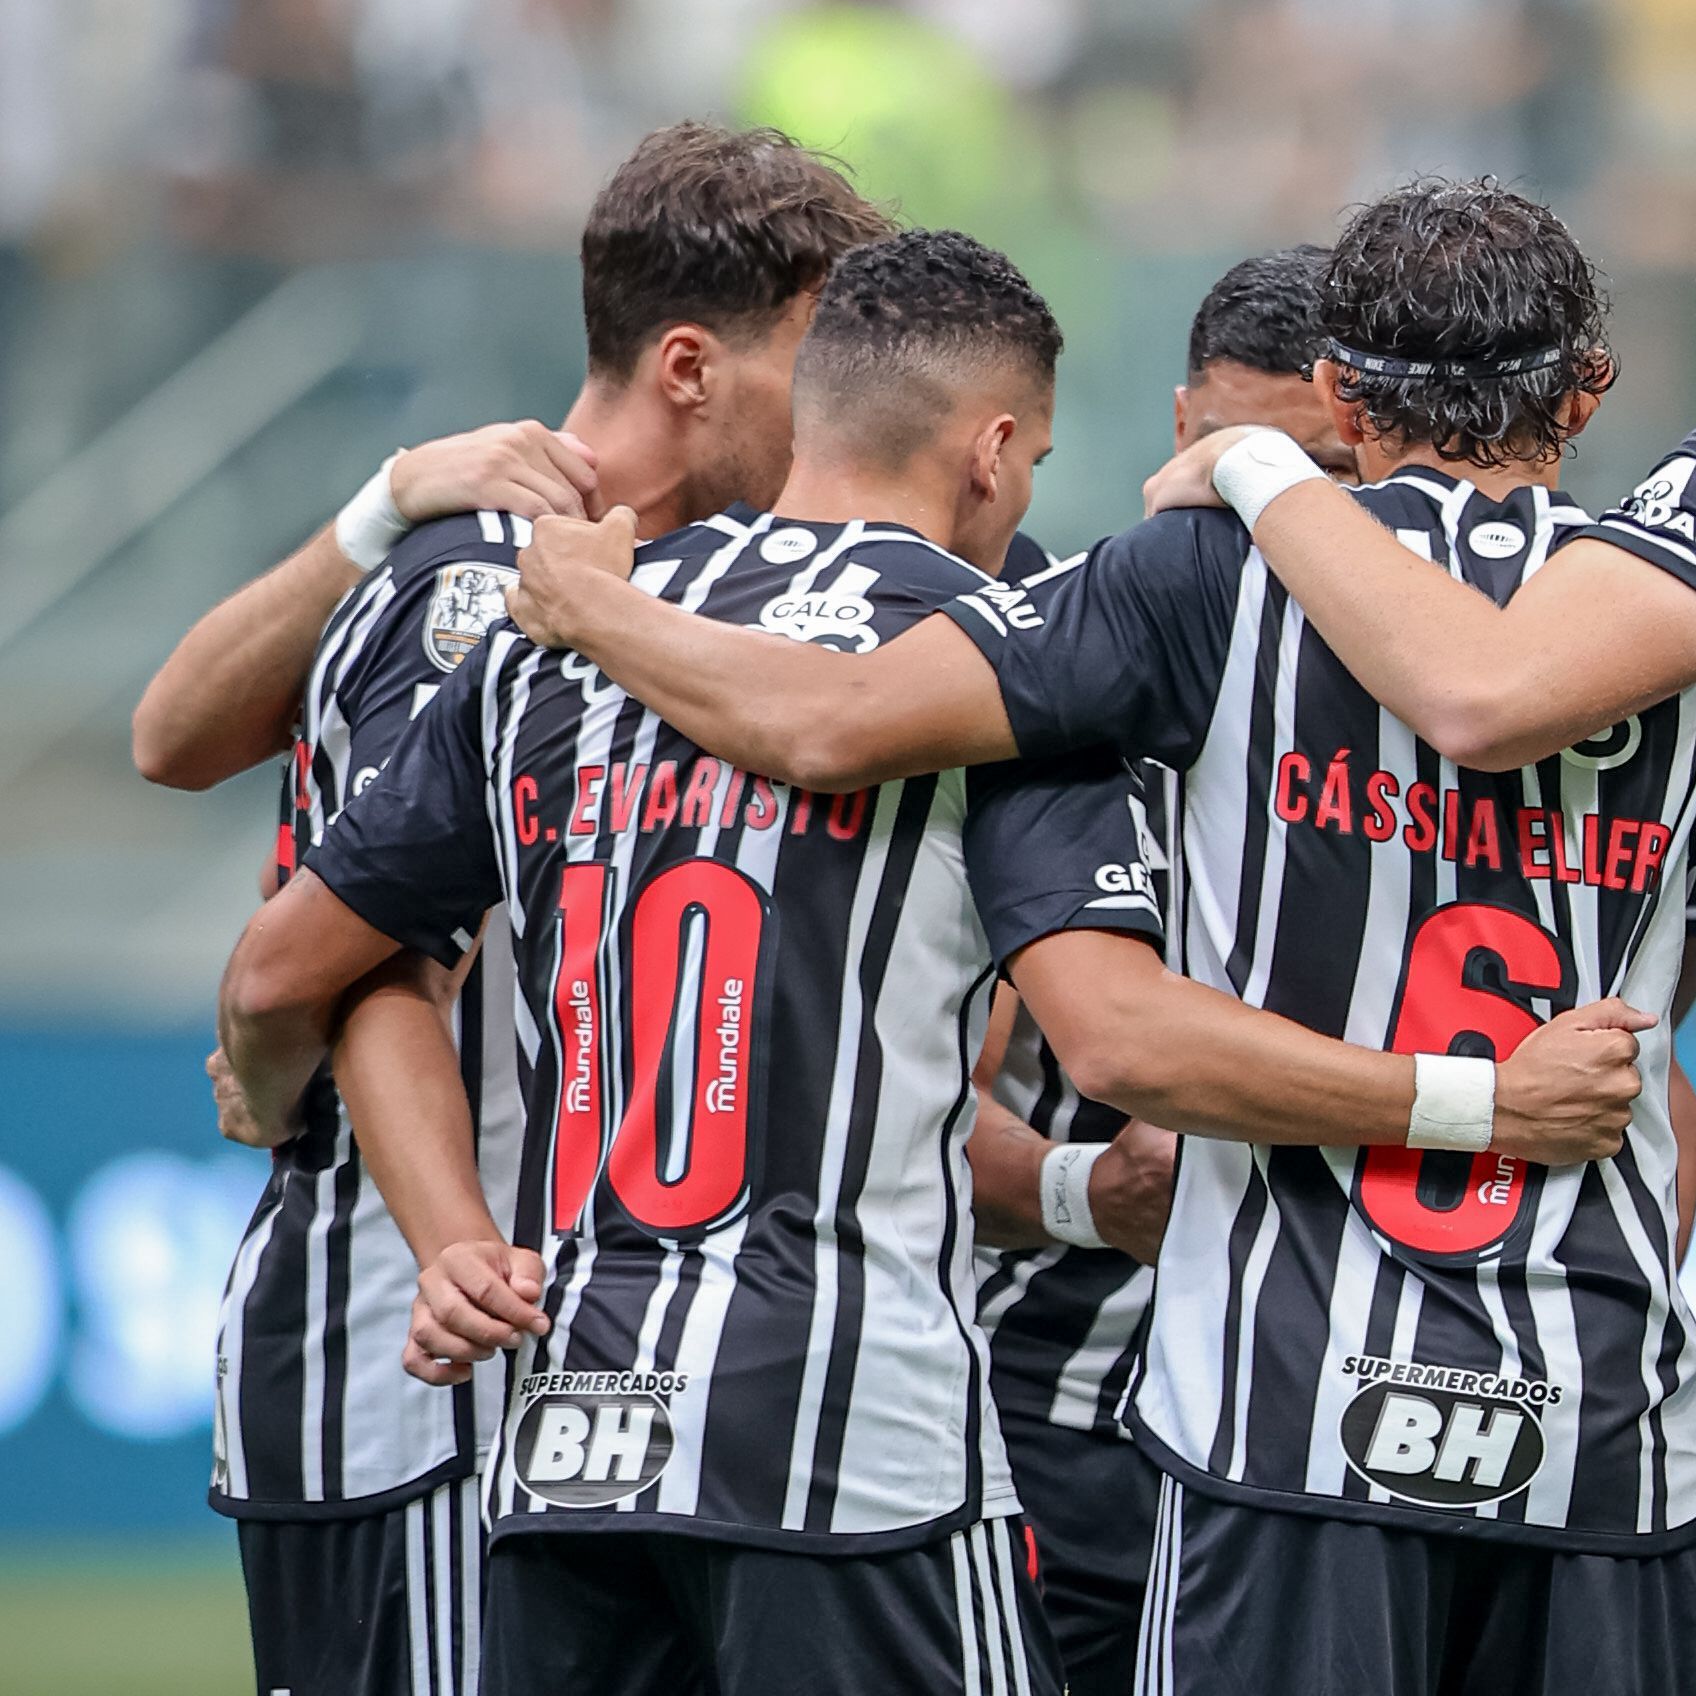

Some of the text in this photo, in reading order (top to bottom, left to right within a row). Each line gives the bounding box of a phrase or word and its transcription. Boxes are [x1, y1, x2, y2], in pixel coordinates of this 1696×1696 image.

[772, 601, 860, 620] GALO
[513, 755, 867, 847] C. EVARISTO
[1274, 747, 1673, 894] CÁSSIA ELLER
[553, 858, 765, 1235] 10
[566, 979, 590, 1114] mundiale
[705, 978, 744, 1115] mundiale
[519, 1373, 689, 1396] SUPERMERCADOS
[1341, 1355, 1563, 1405] SUPERMERCADOS
[526, 1403, 657, 1482] BH
[1363, 1391, 1525, 1488] BH
